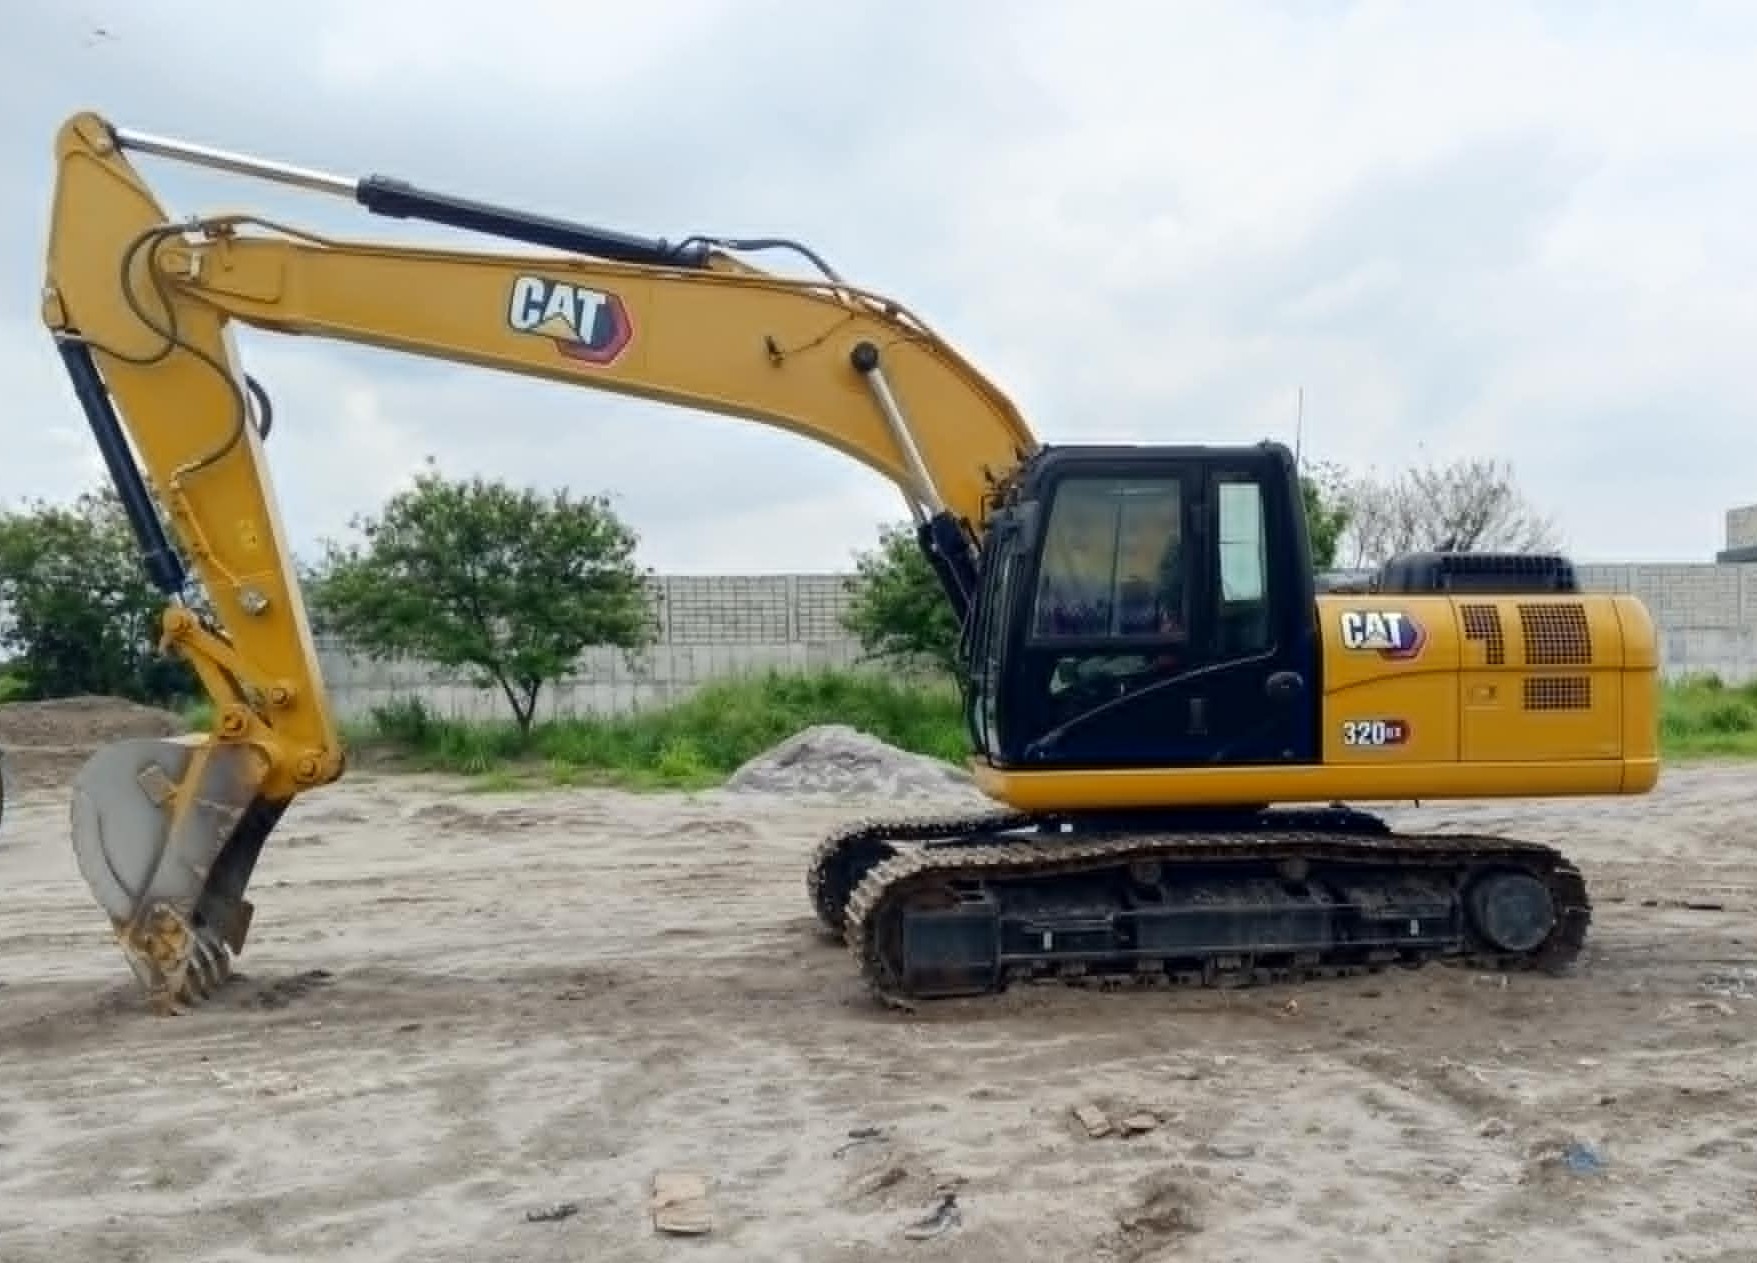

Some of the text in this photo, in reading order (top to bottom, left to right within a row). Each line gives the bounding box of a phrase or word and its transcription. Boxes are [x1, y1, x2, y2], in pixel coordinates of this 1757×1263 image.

[509, 276, 606, 344] CAT
[1341, 611, 1401, 648] CAT
[1343, 720, 1385, 744] 320
